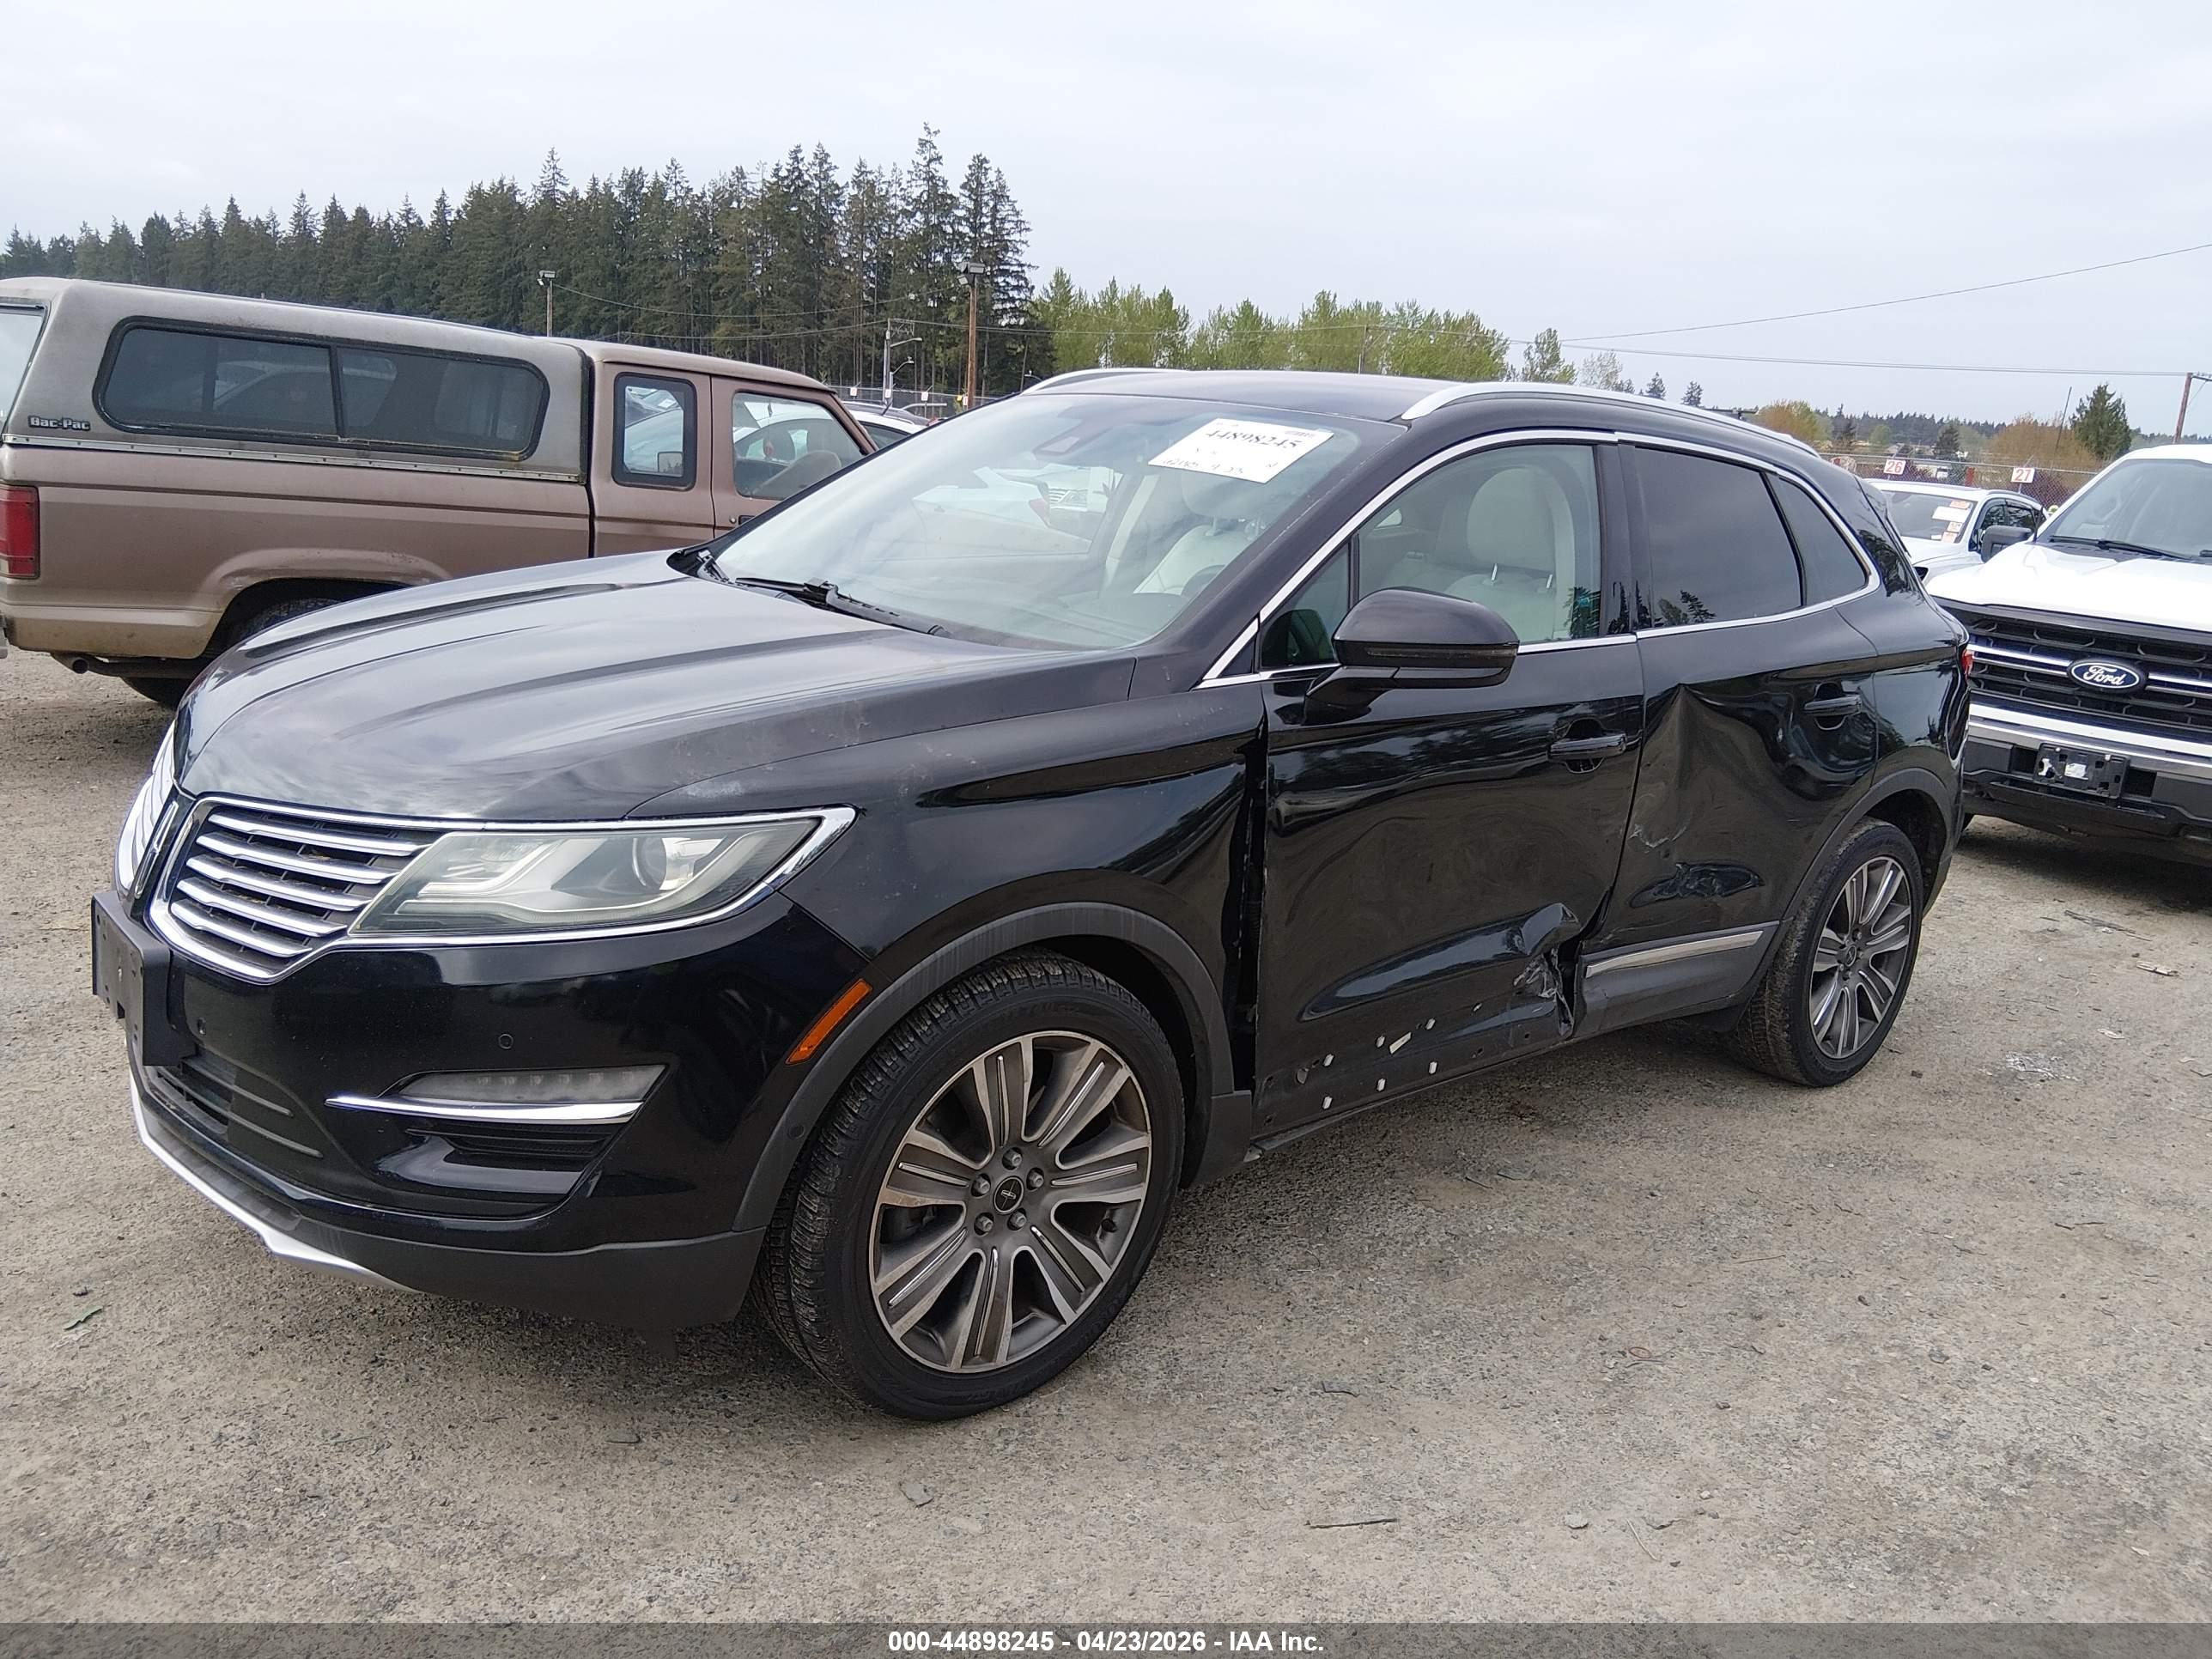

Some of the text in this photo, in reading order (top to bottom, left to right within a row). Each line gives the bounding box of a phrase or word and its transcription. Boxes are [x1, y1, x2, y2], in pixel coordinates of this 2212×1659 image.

[29, 416, 90, 430] Bac-Pac
[1205, 430, 1303, 448] 44898245
[1887, 461, 1903, 473] 26
[2016, 469, 2031, 482] 27
[2083, 665, 2127, 685] Ford
